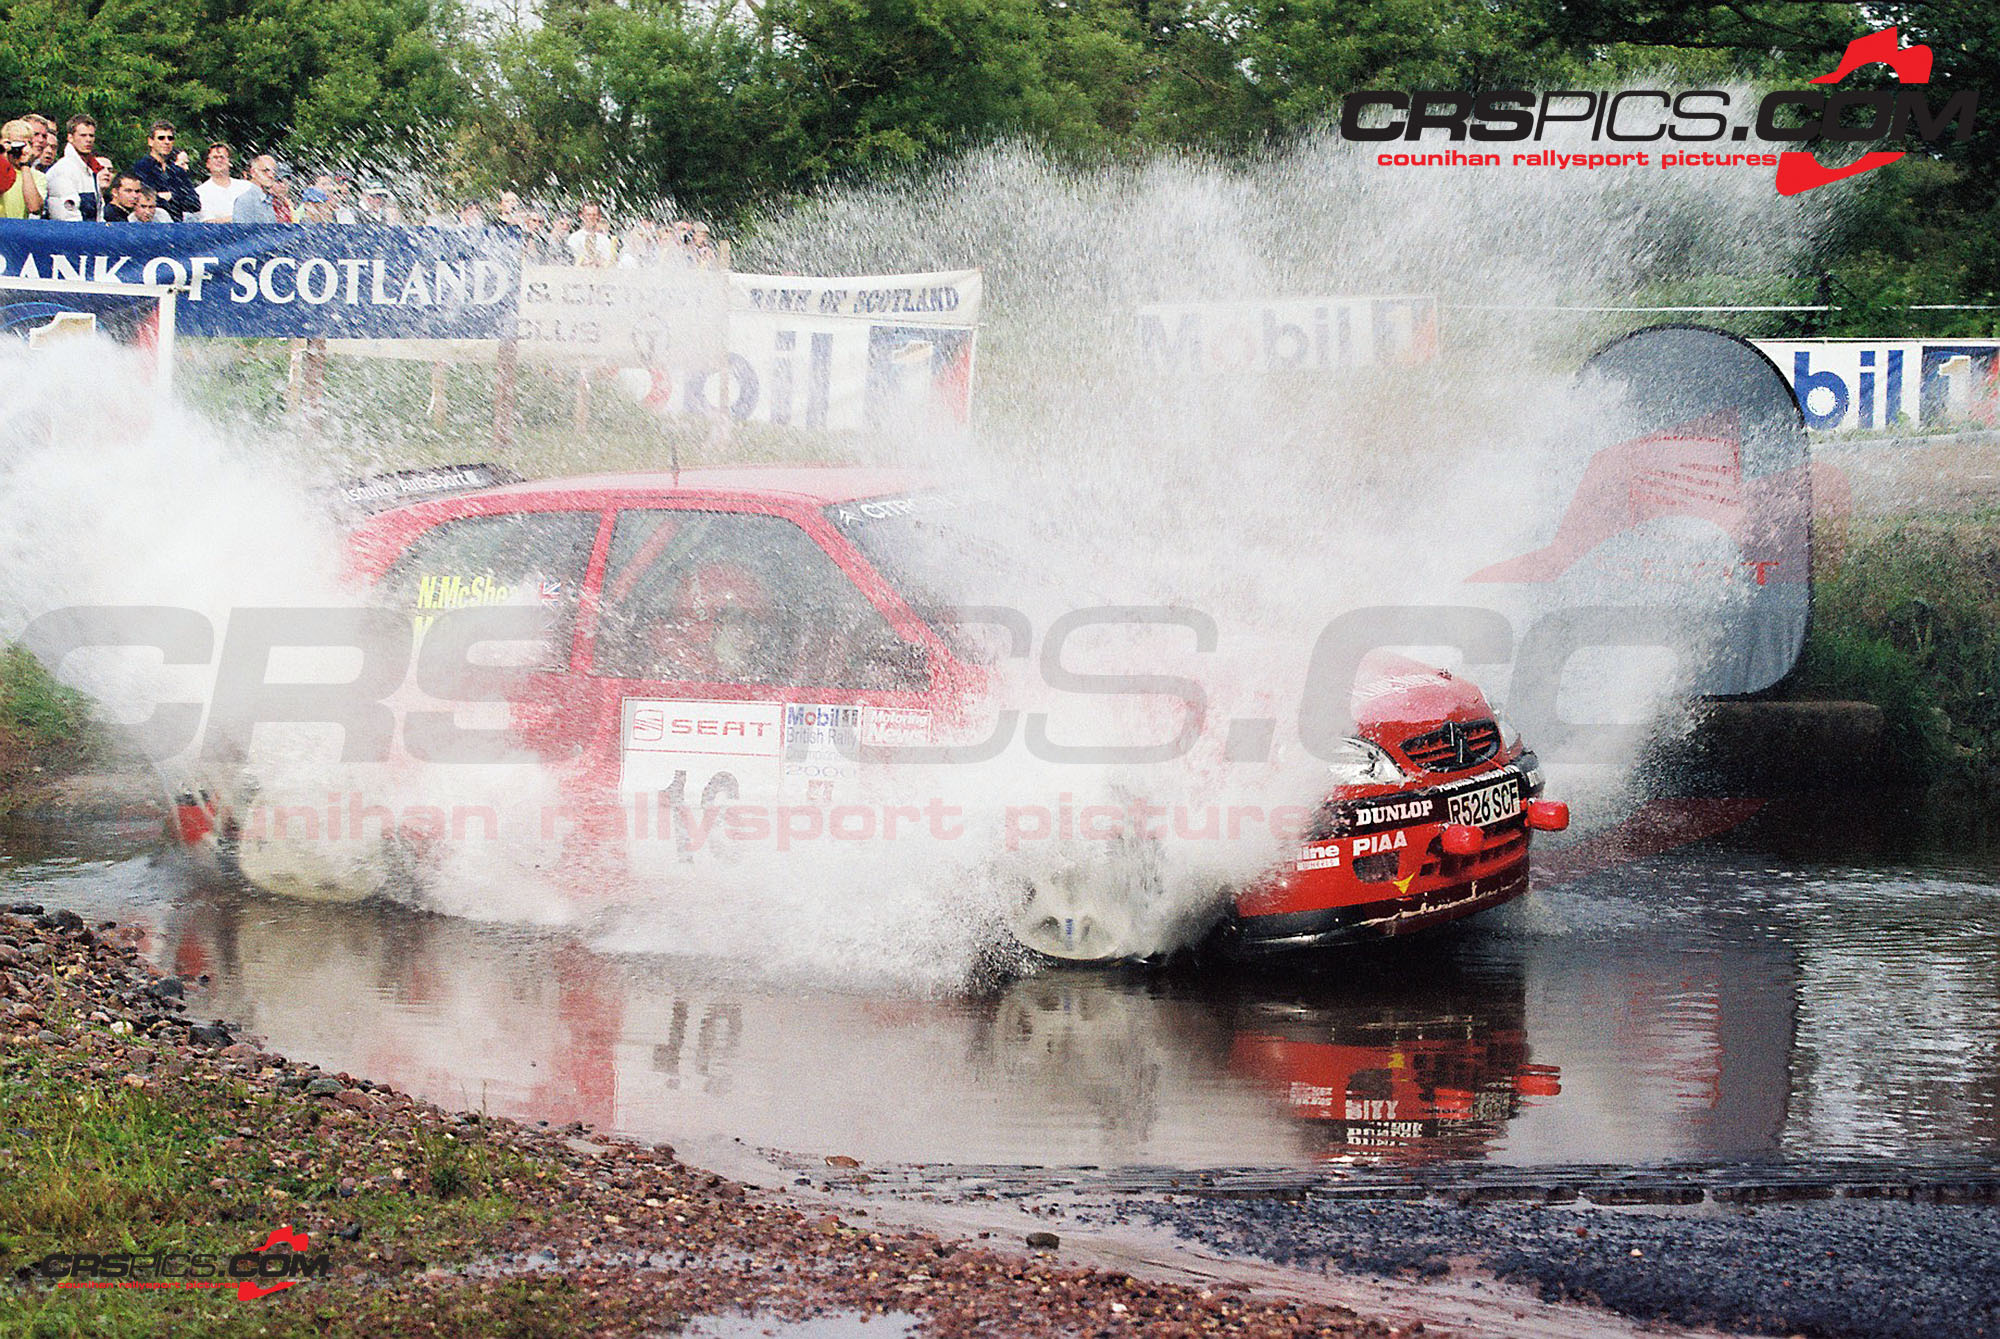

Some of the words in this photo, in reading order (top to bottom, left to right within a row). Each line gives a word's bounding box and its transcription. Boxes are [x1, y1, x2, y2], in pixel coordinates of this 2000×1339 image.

[143, 256, 219, 301] OF
[230, 256, 509, 305] SCOTLAND
[818, 289, 848, 313] OF
[853, 287, 960, 313] SCOTLAND
[671, 718, 772, 738] SEAT
[787, 706, 839, 727] Mobil
[786, 727, 824, 744] British
[829, 729, 858, 748] Rally
[1356, 799, 1433, 826] DUNLOP
[1450, 791, 1492, 827] R526
[1492, 781, 1519, 818] SCF
[1353, 830, 1408, 857] PIAA
